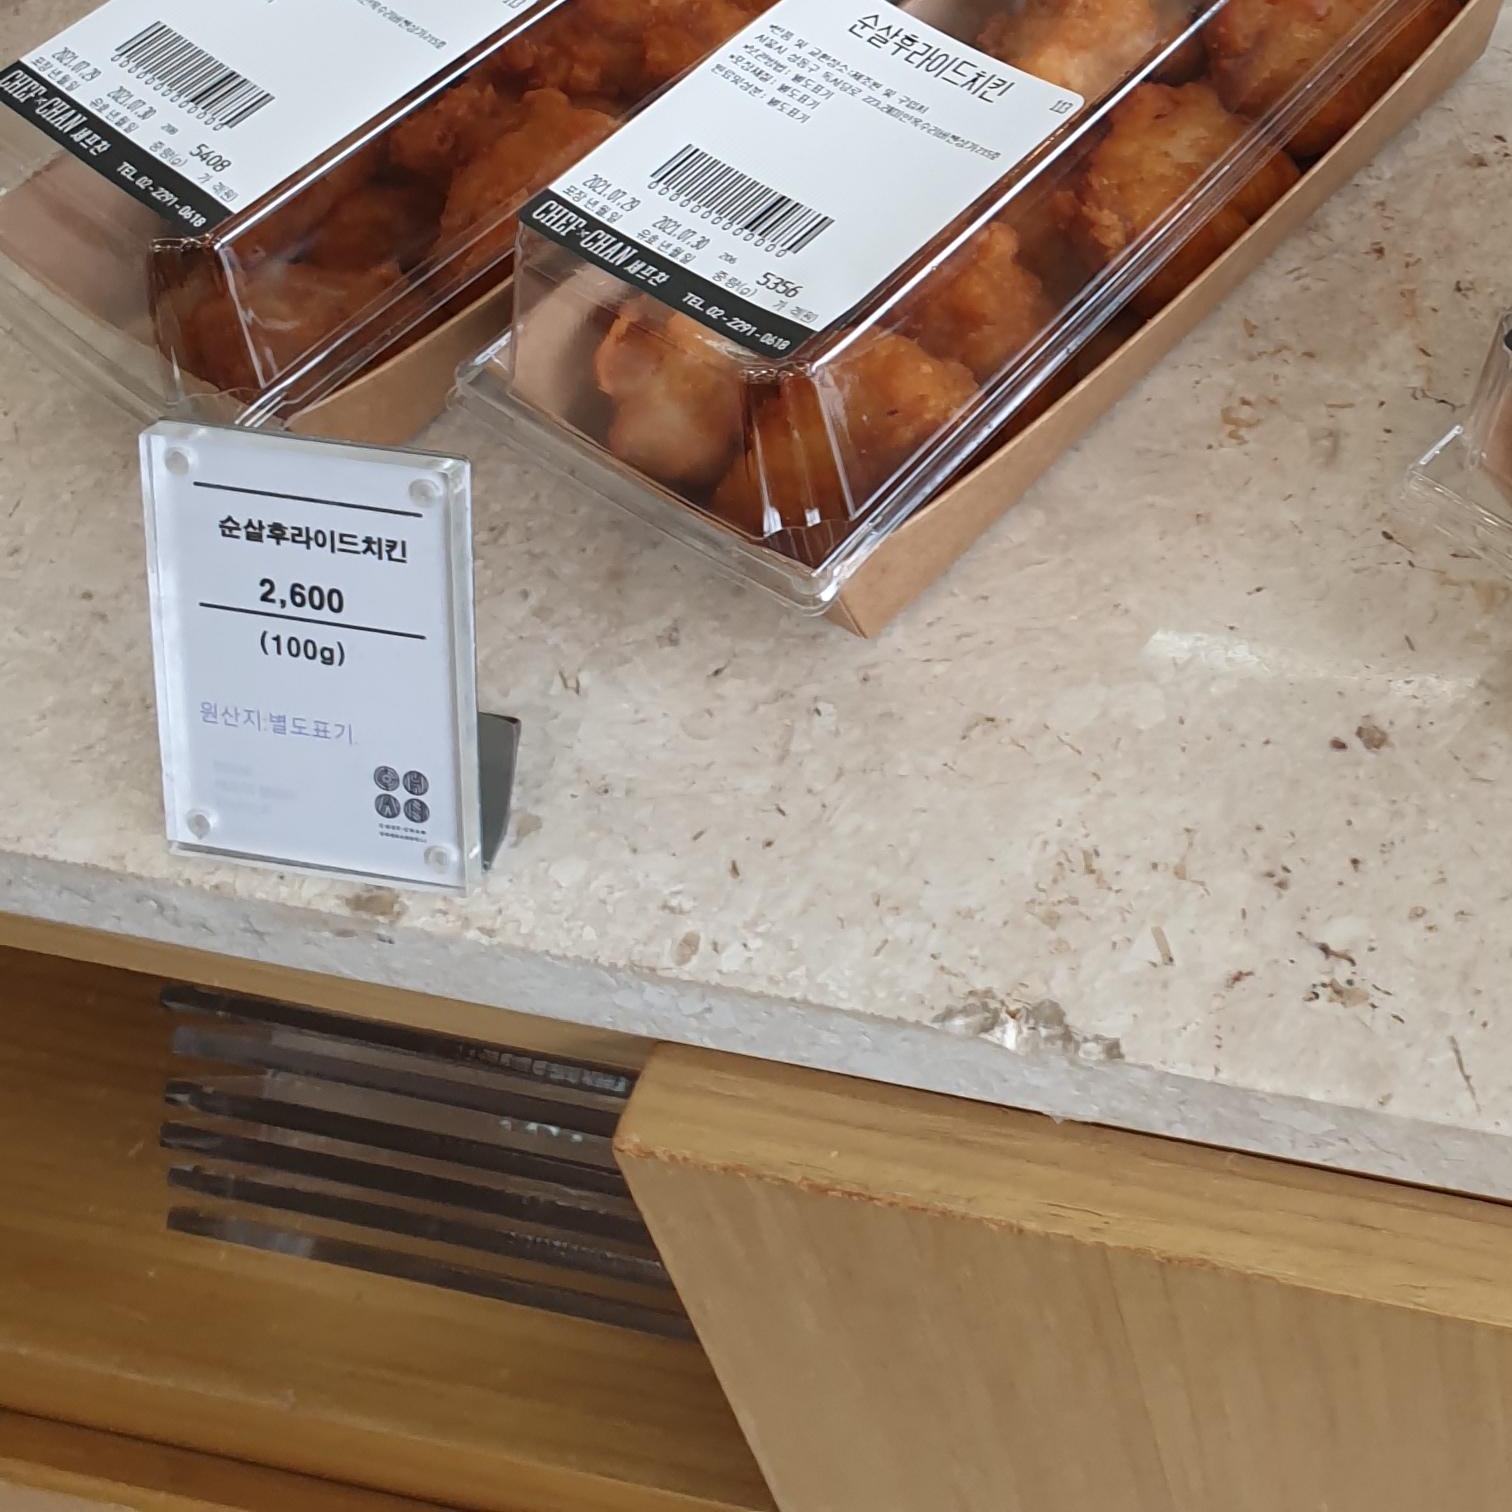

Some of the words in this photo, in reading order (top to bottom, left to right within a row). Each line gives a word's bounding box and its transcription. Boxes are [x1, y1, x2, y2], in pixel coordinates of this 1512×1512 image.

[848, 14, 1015, 103] 순살후라이드치킨
[51, 46, 101, 81] 2021.07.29
[106, 85, 156, 120] 2021.07.30
[188, 143, 231, 172] 5408
[1048, 99, 1073, 114] 113
[573, 173, 641, 211] 2021.07.29
[651, 215, 710, 250] 2021.07.30
[755, 271, 803, 298] 5356
[218, 514, 408, 564] 순살후라이드치킨
[259, 577, 345, 614] 2,600
[259, 630, 346, 667] (100g)
